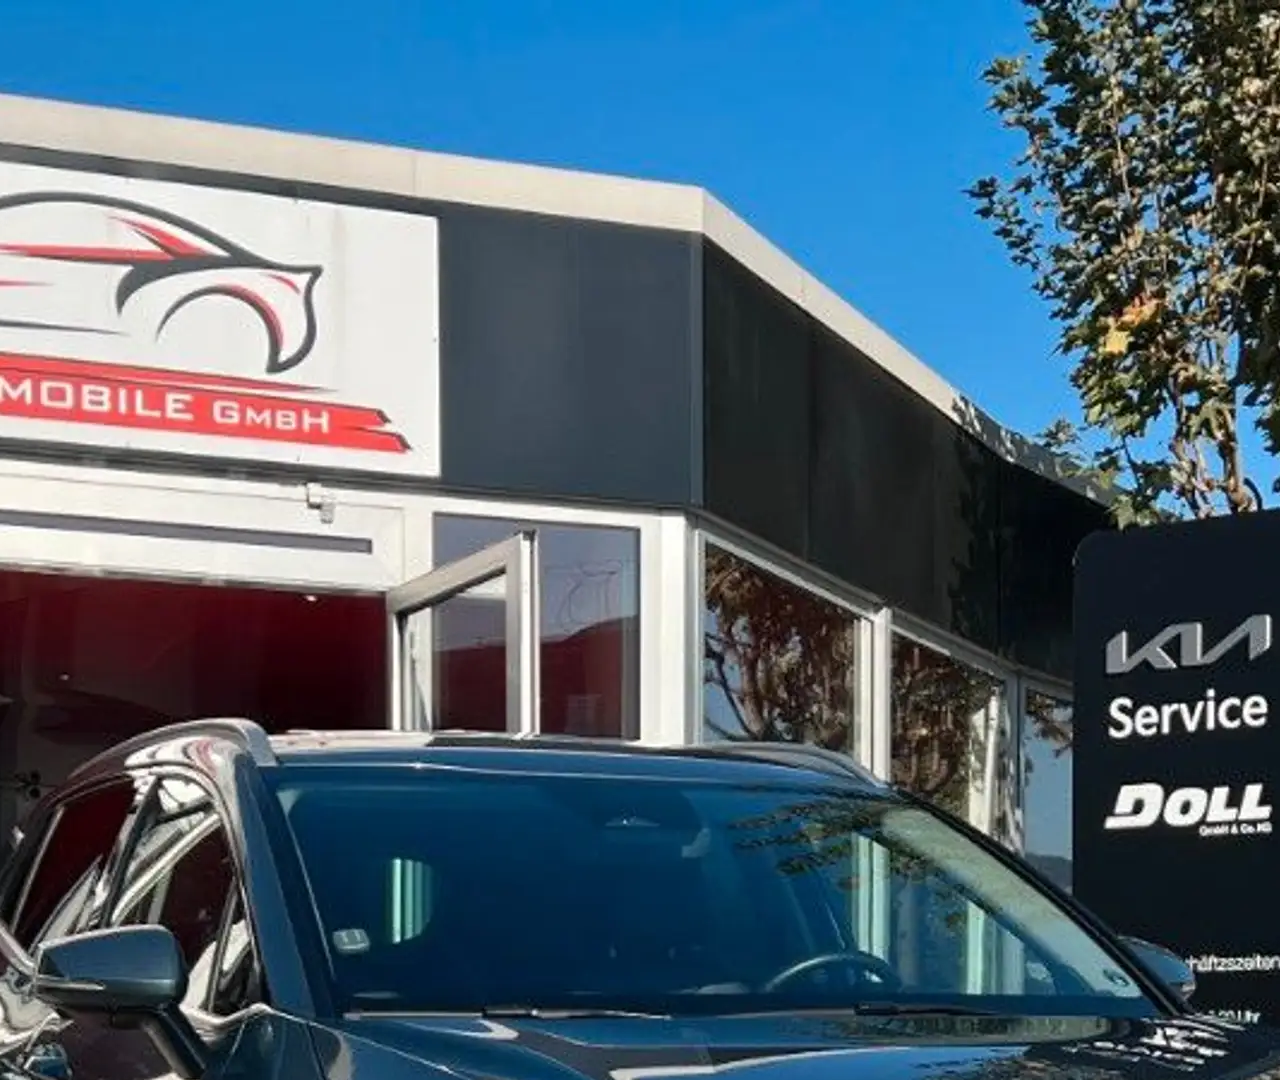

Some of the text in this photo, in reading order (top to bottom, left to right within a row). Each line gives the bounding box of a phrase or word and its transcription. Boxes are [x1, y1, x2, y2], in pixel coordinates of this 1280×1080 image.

[1105, 613, 1273, 675] KIA
[1107, 688, 1270, 739] Service
[1104, 782, 1273, 830] DOLL
